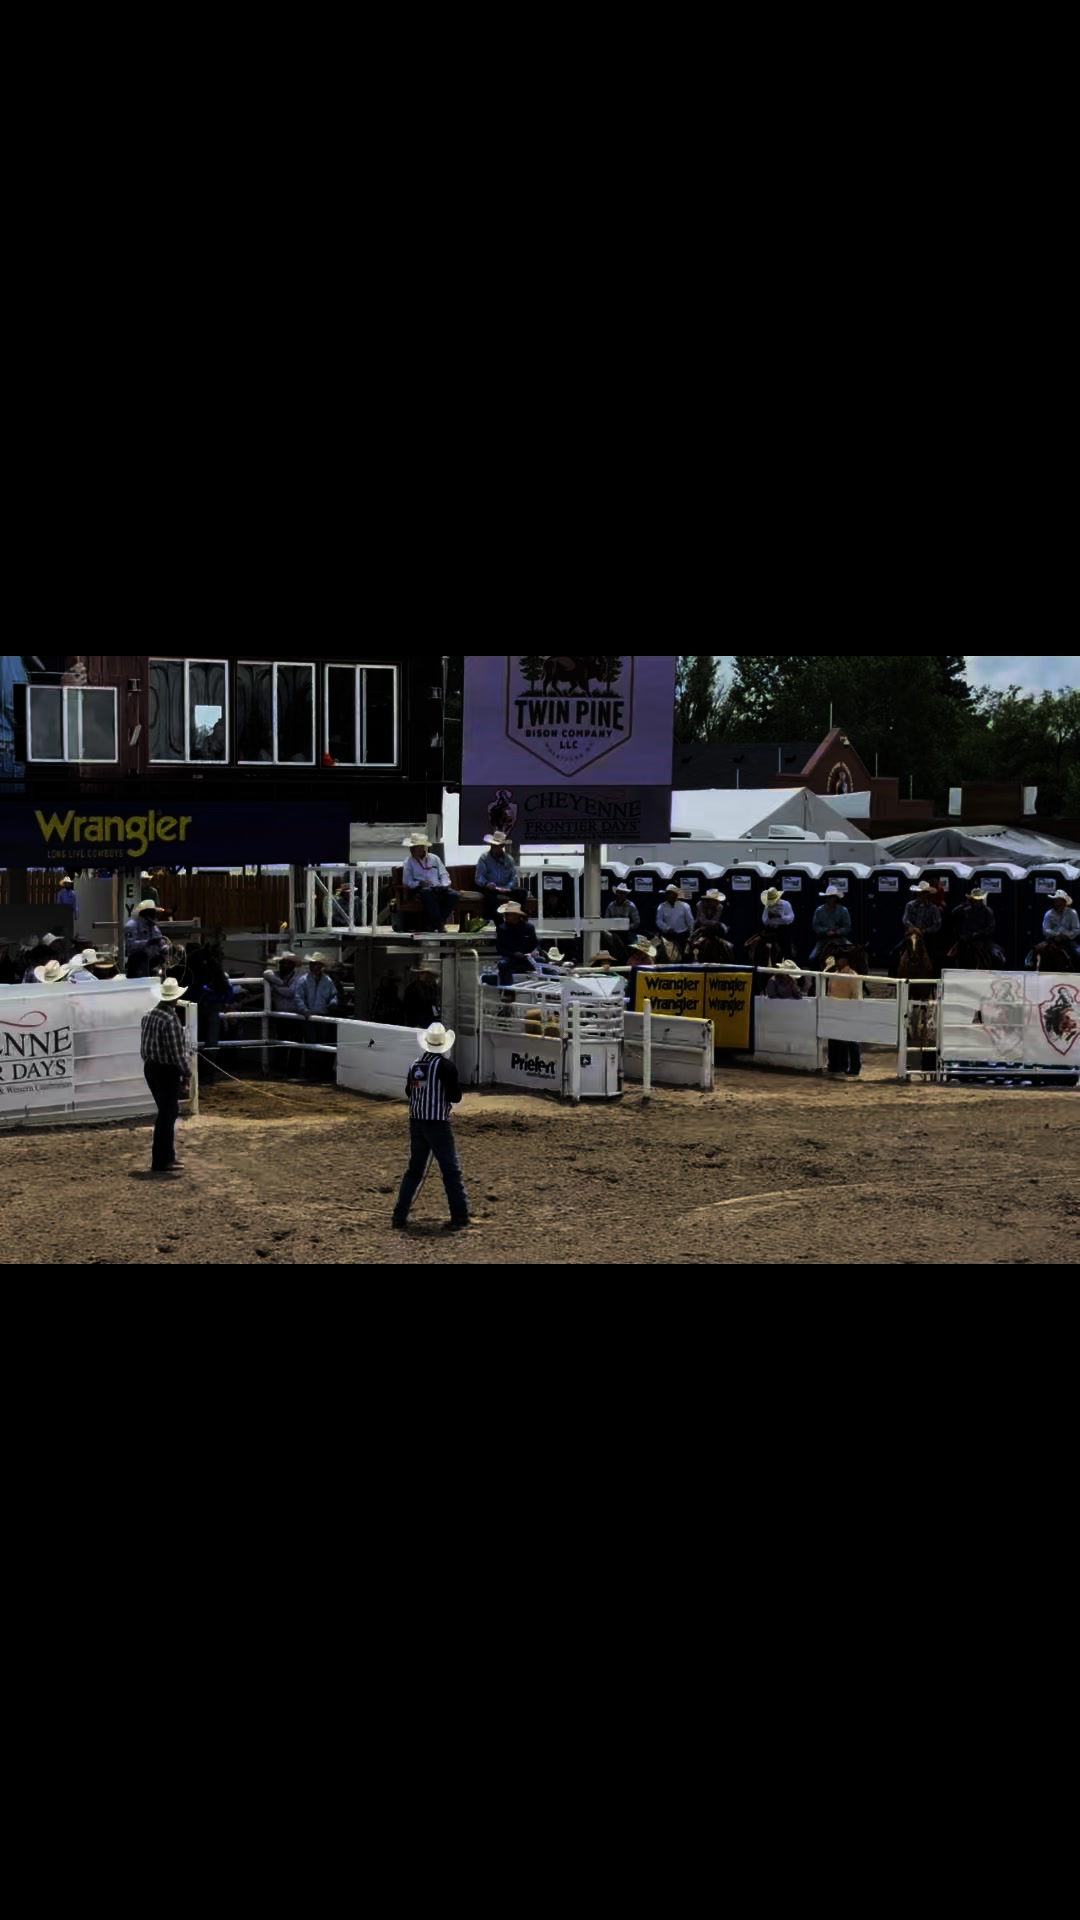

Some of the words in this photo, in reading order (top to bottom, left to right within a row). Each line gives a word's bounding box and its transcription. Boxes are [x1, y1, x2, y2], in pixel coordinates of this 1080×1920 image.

[515, 700, 570, 729] TWIN
[576, 700, 625, 731] PINE
[526, 729, 558, 738] BISON
[562, 729, 612, 738] COMPANY
[560, 740, 578, 749] LLC
[524, 791, 641, 818] CHEYENNE
[34, 809, 193, 858] Wrangler
[526, 821, 597, 833] FRONTIER
[601, 821, 637, 833] DAYS
[644, 976, 700, 997] Wrangler
[708, 977, 747, 998] Wrangler
[708, 996, 746, 1017] Wrangler
[0, 1026, 72, 1057] NNE
[12, 1059, 66, 1080] DAYS
[511, 1052, 556, 1074] Priefert
